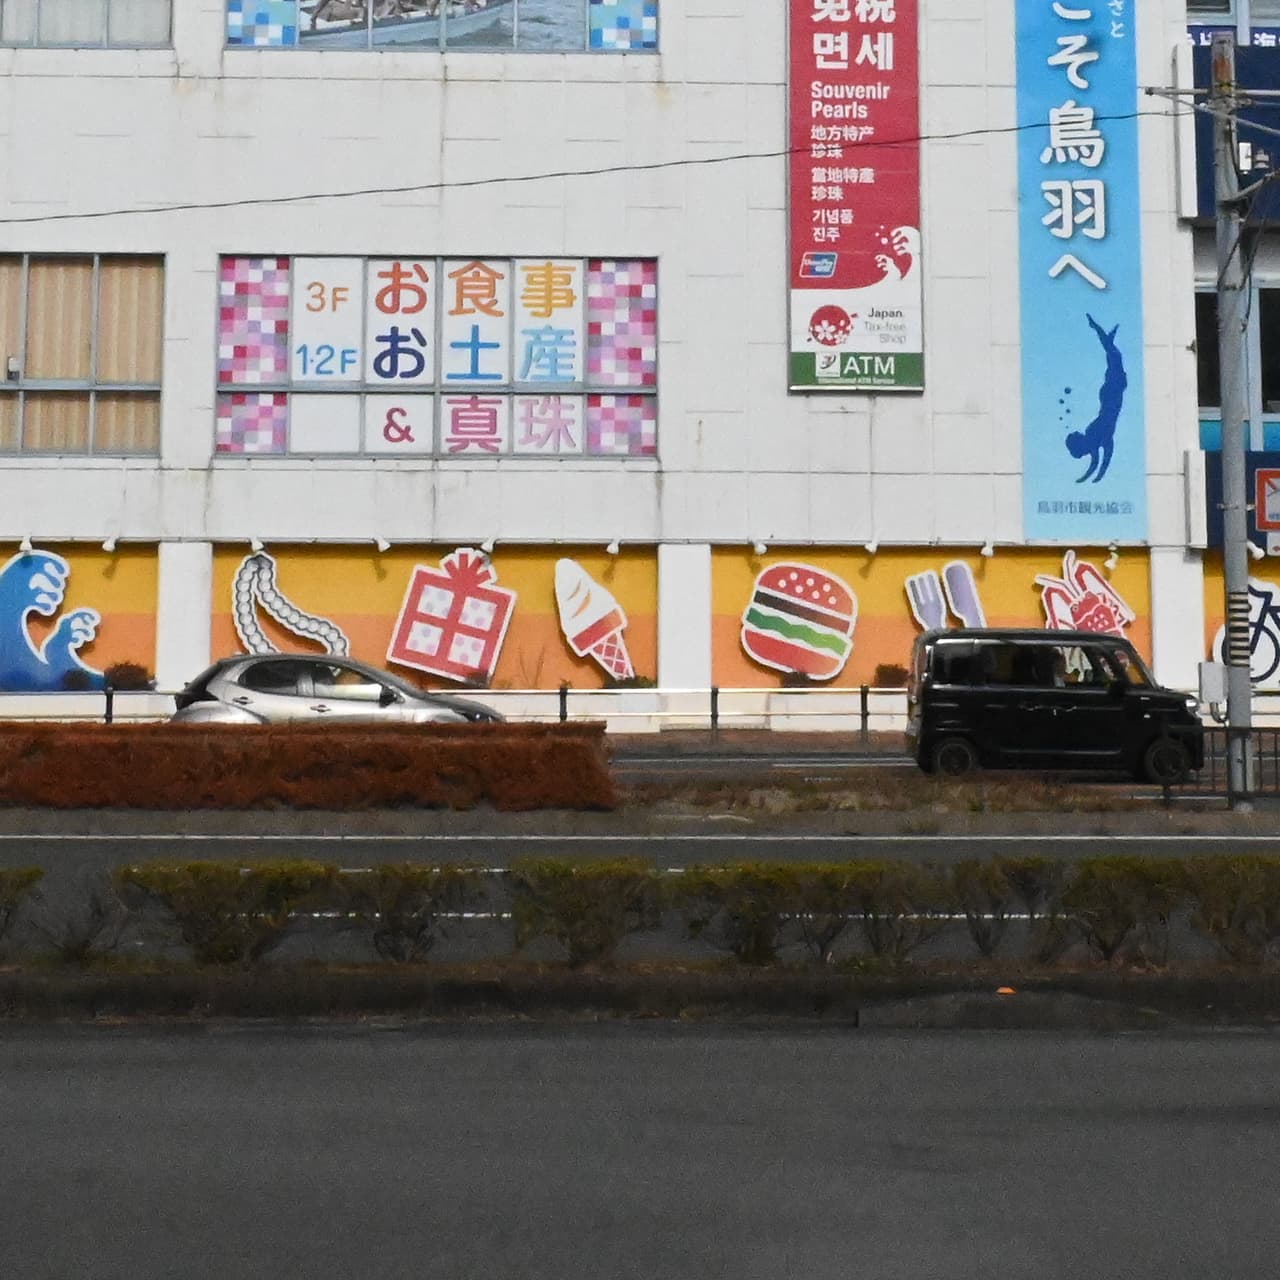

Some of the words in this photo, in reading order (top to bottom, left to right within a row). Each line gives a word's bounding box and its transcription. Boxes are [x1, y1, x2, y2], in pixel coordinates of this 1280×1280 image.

[812, 31, 894, 71] 면세
[811, 80, 891, 100] Souvenir
[811, 100, 869, 120] Pearls
[810, 125, 875, 141] 地方特产
[810, 143, 844, 160] 珍珠
[811, 185, 844, 202] 珍珠
[812, 208, 854, 225] 기념품
[813, 226, 841, 243] 진주
[304, 280, 350, 313] 3F
[374, 260, 578, 319] お食事
[867, 307, 904, 320] Japan
[373, 323, 578, 383] お土産
[843, 356, 896, 376] ATM
[382, 407, 415, 444] &
[445, 395, 578, 453] 真珠
